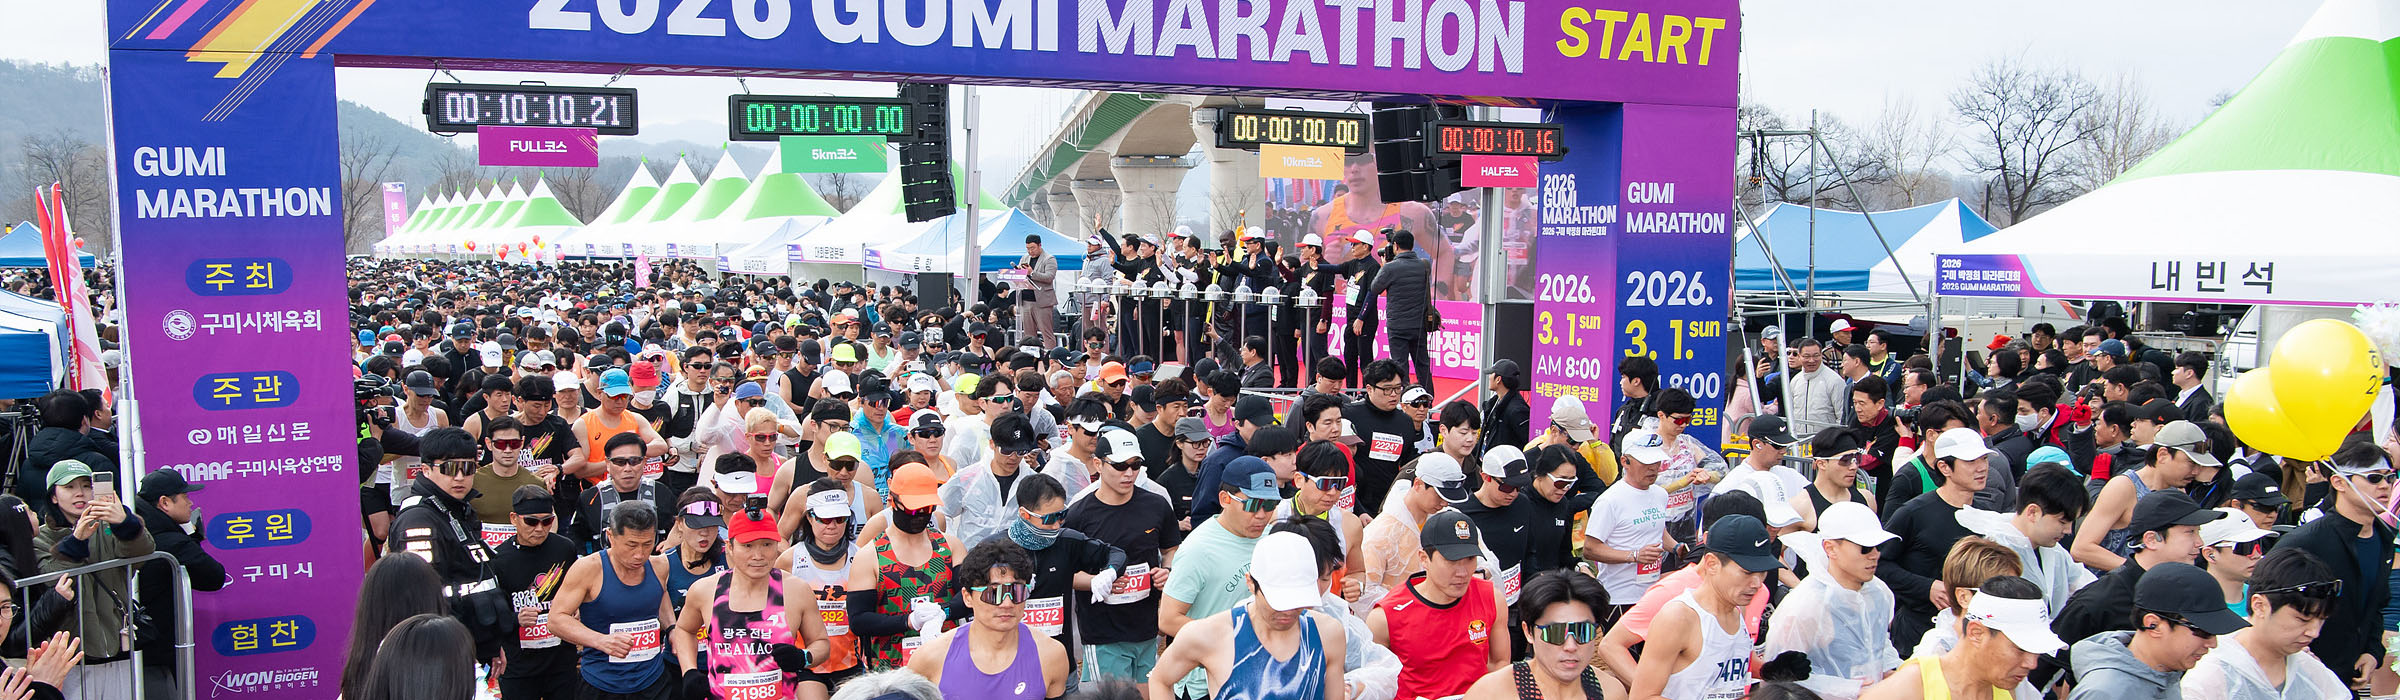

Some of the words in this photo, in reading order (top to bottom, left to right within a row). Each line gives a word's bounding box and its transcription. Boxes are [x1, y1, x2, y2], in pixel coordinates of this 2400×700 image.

[1077, 0, 1524, 73] MARATHON
[1554, 7, 1726, 66] START
[445, 91, 620, 126] 00:10:10.21
[747, 103, 904, 133] 00:00:00.00
[1233, 114, 1359, 145] 00:00:00.00
[510, 140, 568, 153] FULL코스
[1441, 127, 1554, 154] 00:00:10.16
[133, 146, 226, 177] GUMI
[811, 148, 858, 161] 5km코스
[1282, 156, 1323, 168] 10km코스
[1481, 166, 1520, 177] HALF코스
[1543, 173, 1576, 192] 2026
[1627, 181, 1675, 204] GUMI
[136, 187, 332, 219] MARATHON
[1543, 190, 1578, 209] GUMI
[1542, 204, 1617, 225] MARATHON
[1626, 211, 1725, 234] MARATHON
[1941, 258, 1962, 269] 2026
[1941, 269, 1957, 281] 구미
[1958, 269, 1980, 282] 박정희
[1982, 270, 2021, 282] 마라톤대회
[1539, 273, 1596, 304] 2026.
[1626, 270, 1713, 307] 2026.
[1941, 282, 1960, 291] 2026
[1960, 282, 1979, 291] GUMI
[1979, 283, 2021, 292] MARATHON
[201, 309, 322, 335] 구미시체육회
[1579, 314, 1601, 330] sun
[1689, 320, 1720, 338] sun
[1536, 354, 1562, 377] AM
[1565, 356, 1600, 380] 8:00
[1535, 381, 1599, 402] 낙동강체육공원
[1669, 372, 1721, 399] 8:00
[217, 422, 311, 445] 매일신문
[1374, 440, 1400, 452] 22247
[236, 455, 343, 478] 구미시육상연맹
[1335, 495, 1353, 508] 0934
[1633, 516, 1651, 526] RUN
[242, 561, 313, 583] 구미시
[1225, 568, 1245, 593] GUMI
[511, 588, 537, 600] 2026
[1021, 609, 1059, 623] 21372
[723, 628, 747, 640] 광주
[749, 628, 773, 640] 전남
[226, 670, 274, 688] WON
[274, 671, 319, 683] BIOGEN
[731, 684, 776, 700] 21988
